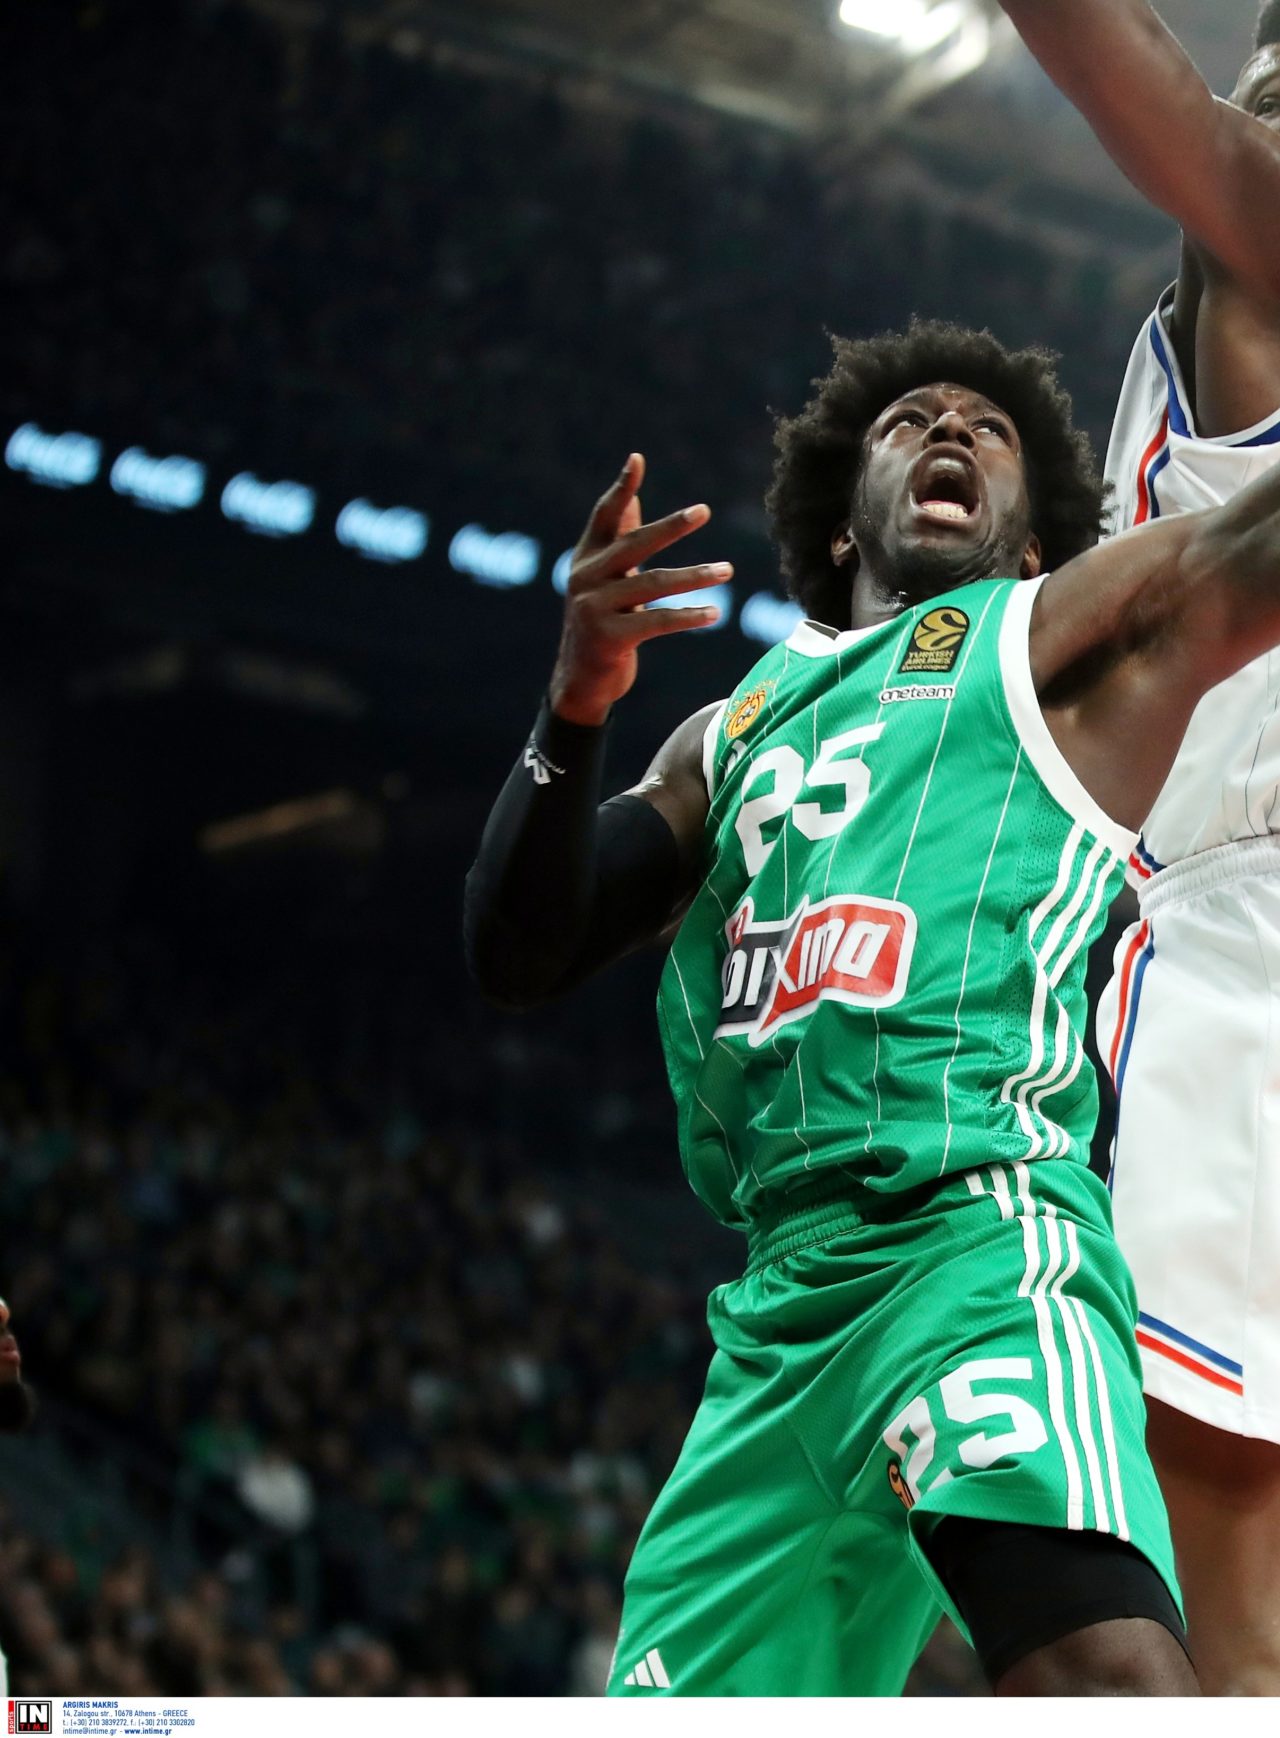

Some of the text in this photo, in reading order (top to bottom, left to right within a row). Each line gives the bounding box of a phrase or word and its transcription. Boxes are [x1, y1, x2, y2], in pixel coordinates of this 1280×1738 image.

[881, 687, 953, 701] oneteam
[735, 722, 887, 877] 25
[882, 1357, 1049, 1504] 25
